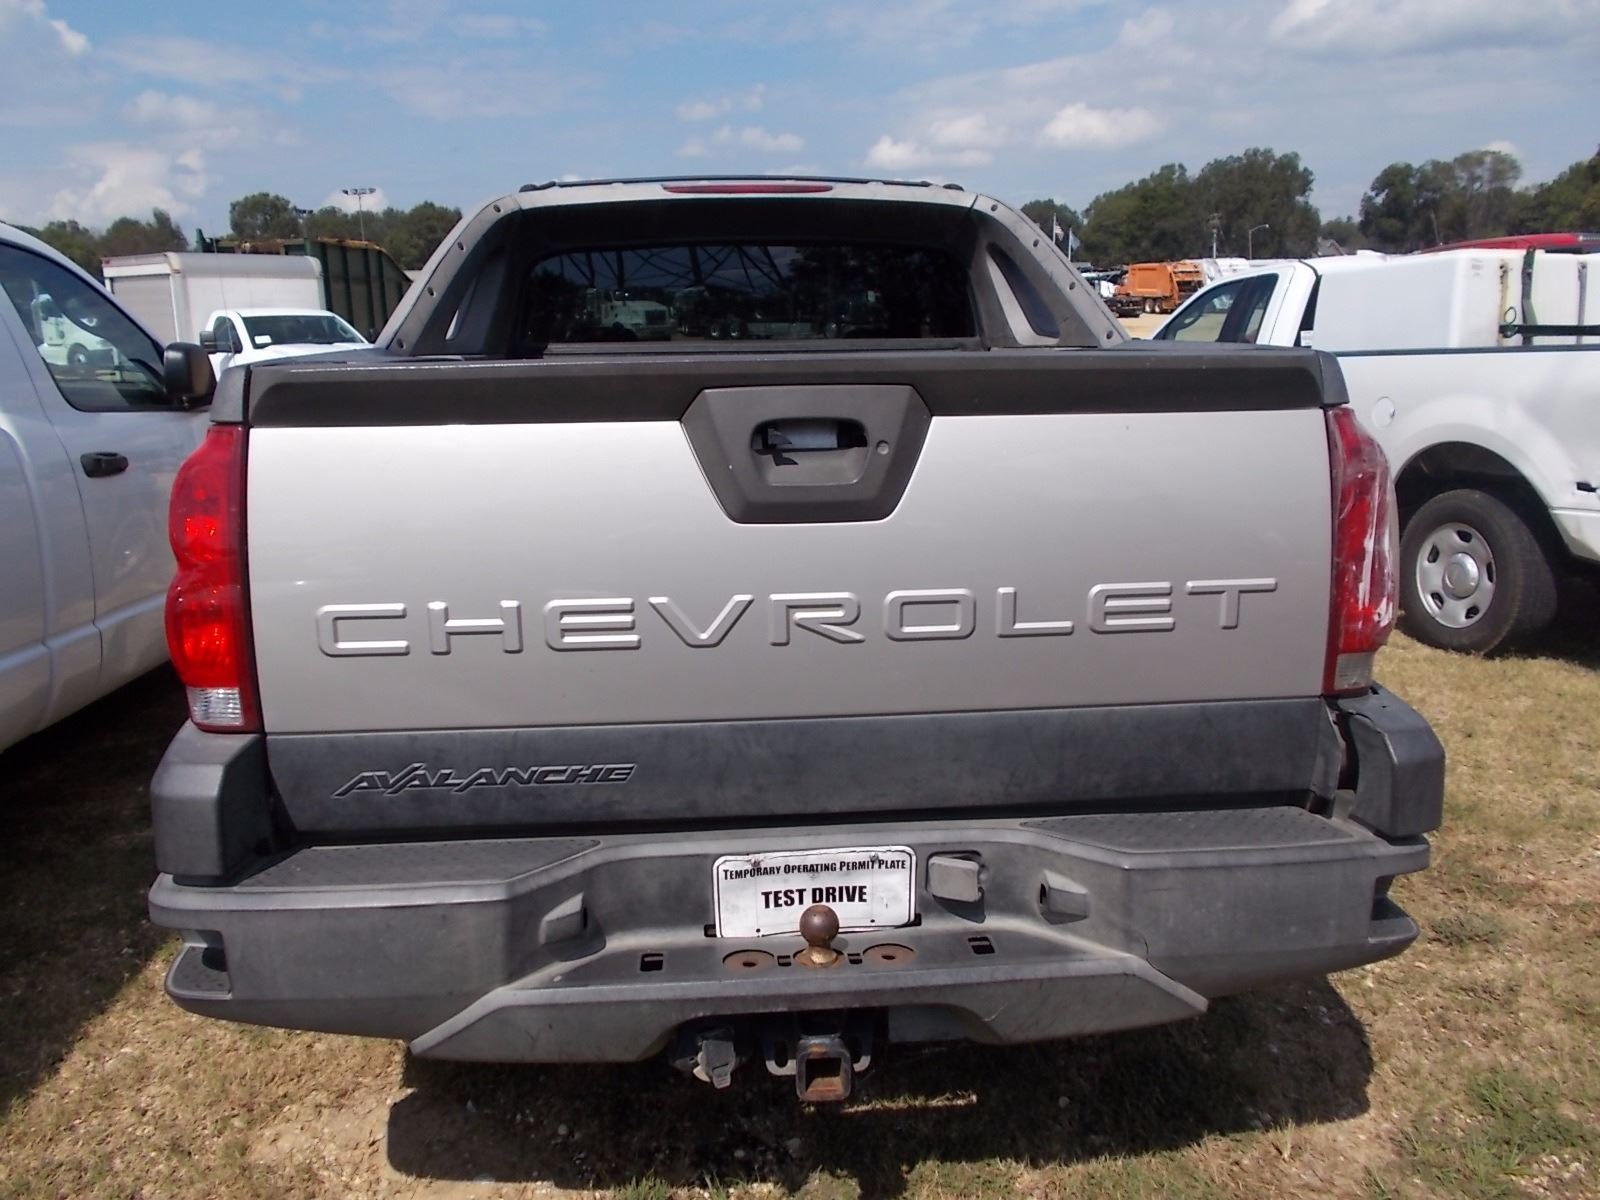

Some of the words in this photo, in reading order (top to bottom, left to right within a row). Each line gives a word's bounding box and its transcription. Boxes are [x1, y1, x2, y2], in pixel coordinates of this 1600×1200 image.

[315, 577, 1278, 657] CHEVROLET
[331, 762, 637, 798] AVALANCHE
[761, 888, 807, 909] TEST
[811, 885, 867, 904] DRIVE
